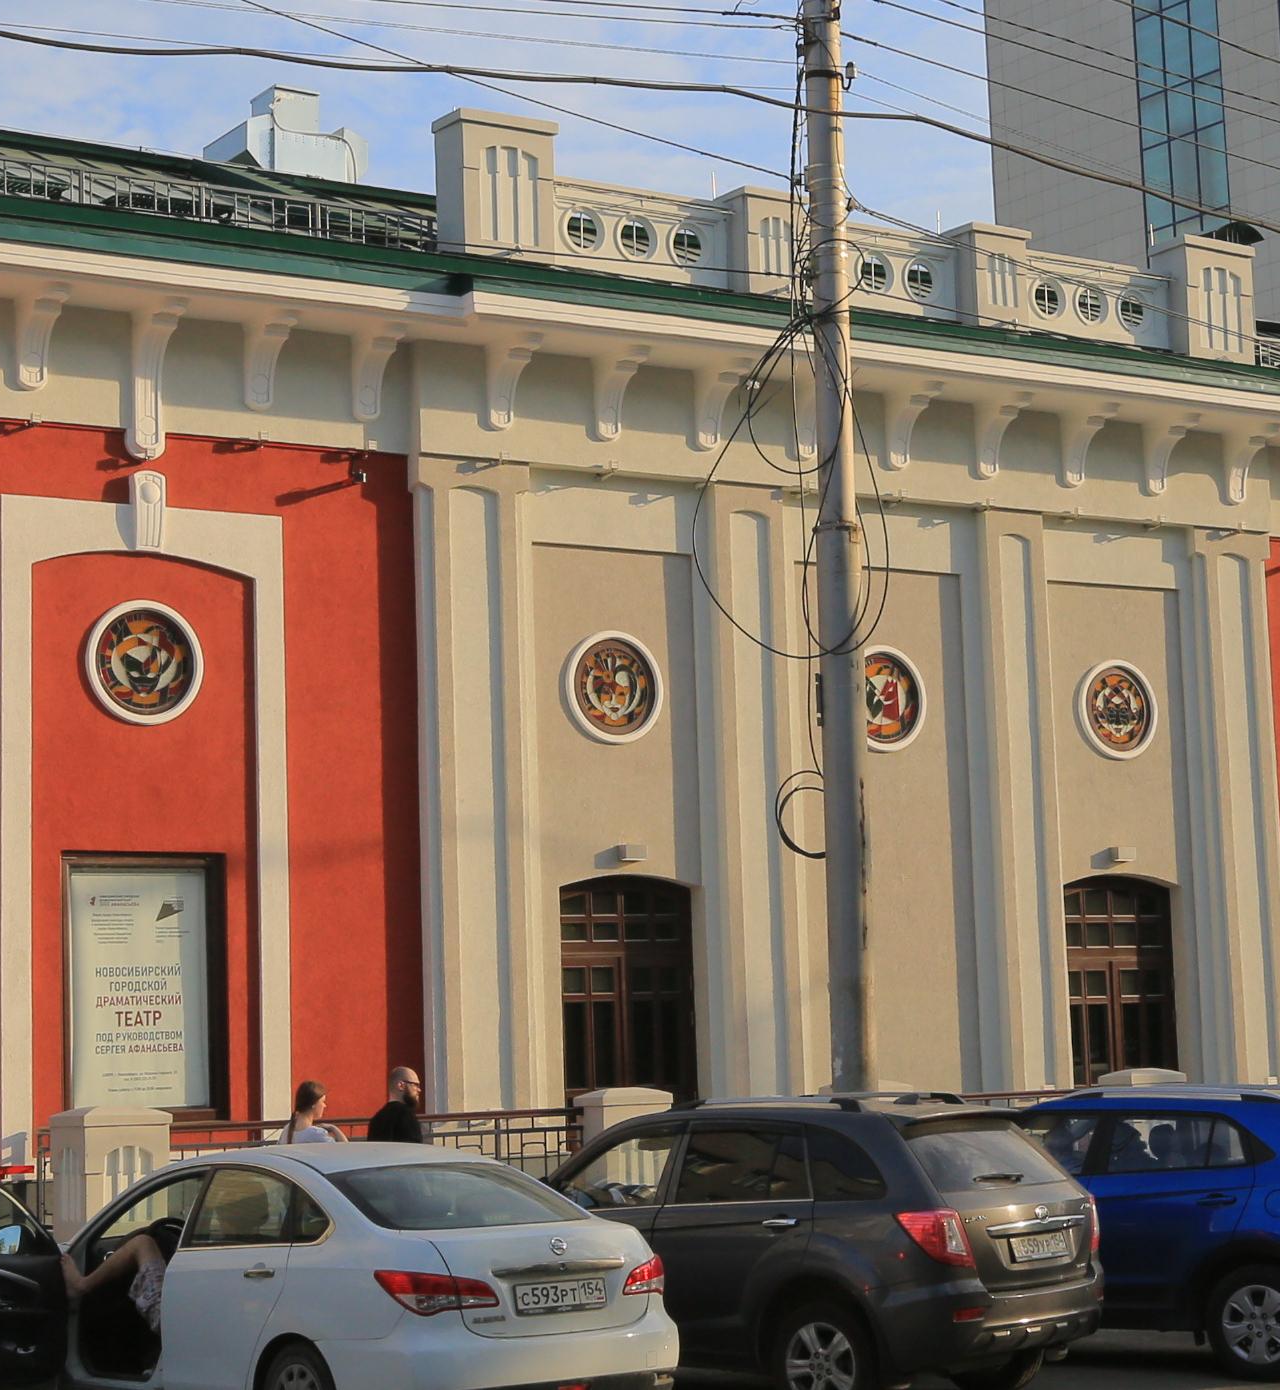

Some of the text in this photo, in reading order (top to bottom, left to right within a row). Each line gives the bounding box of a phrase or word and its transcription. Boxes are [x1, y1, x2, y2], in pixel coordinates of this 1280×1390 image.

[95, 963, 181, 978] НОВОСИБИРСКИЙ
[109, 978, 168, 993] ГОРОДСКОЙ
[95, 992, 182, 1008] ДРАМАТИЧЕСКИЙ
[115, 1010, 162, 1028] ТЕАТР
[95, 1030, 183, 1043] ПОД РУКОВОДСТВОМ
[95, 1042, 184, 1055] СЕРГЕЯ АФАНАСЬЕВА
[580, 1281, 603, 1296] 154
